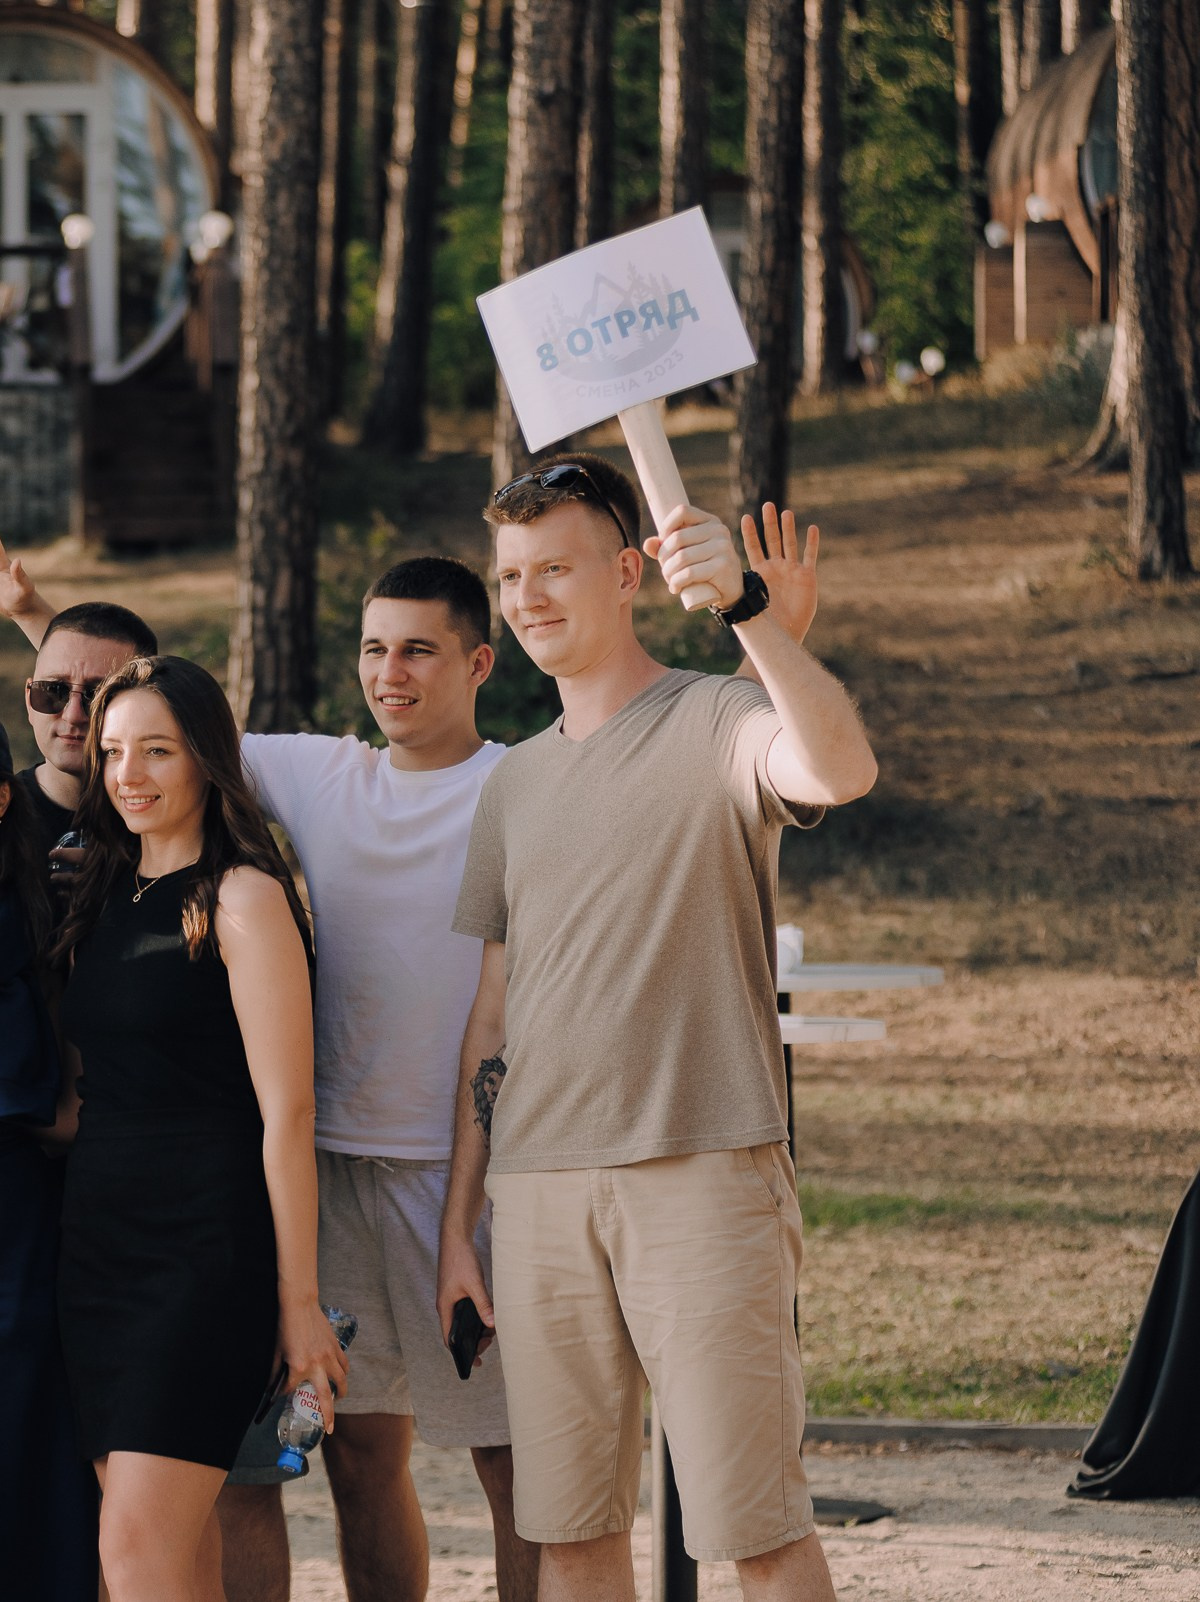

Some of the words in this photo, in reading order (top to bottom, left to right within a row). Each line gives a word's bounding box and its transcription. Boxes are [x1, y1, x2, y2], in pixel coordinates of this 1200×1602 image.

[535, 342, 559, 372] 8
[566, 288, 701, 357] ОТРЯД
[576, 378, 641, 399] СМЕНА
[643, 350, 685, 384] 2023
